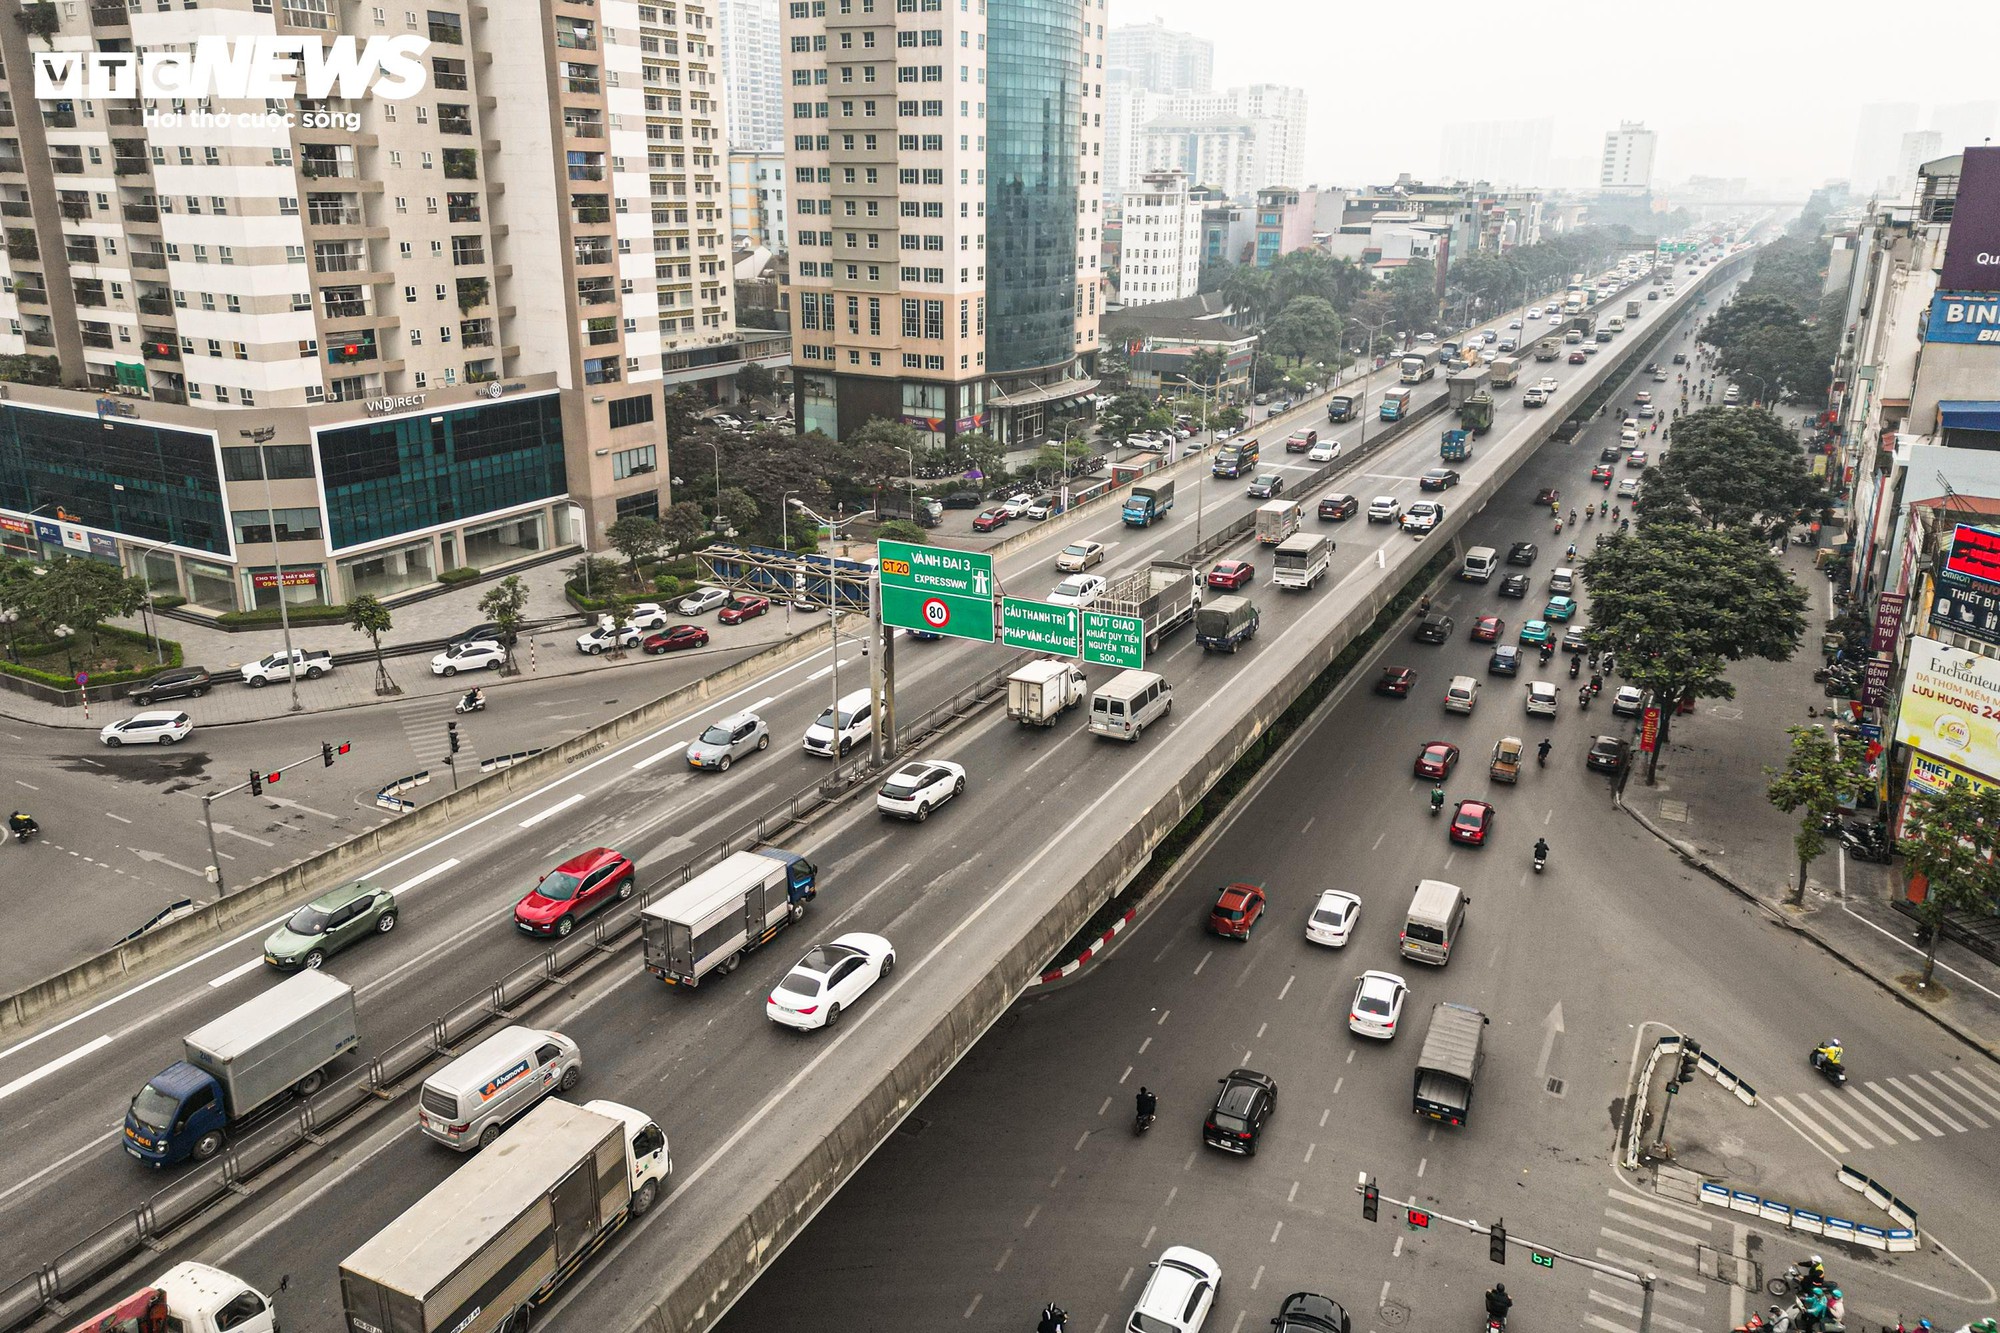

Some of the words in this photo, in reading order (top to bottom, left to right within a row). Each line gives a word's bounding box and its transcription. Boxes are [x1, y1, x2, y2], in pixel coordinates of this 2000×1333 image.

[366, 394, 426, 412] VNDIRECT
[882, 560, 909, 574] CT.20
[911, 550, 940, 567] VÀNH
[943, 556, 962, 571] ĐAI
[964, 560, 970, 571] 3
[914, 573, 967, 590] EXPRESSWAY
[1951, 588, 1982, 605] THIẾT
[1983, 597, 1995, 611] BỊ
[929, 606, 943, 620] 80
[1880, 604, 1901, 615] BỆNH
[1022, 609, 1050, 623] THANH
[1051, 613, 1066, 626] TRÌ
[1879, 615, 1897, 626] VIỆN
[1112, 619, 1135, 631] GIAO
[1004, 627, 1026, 639] PHÁP
[1086, 628, 1107, 639] KHUẤT
[1108, 632, 1122, 642] DUY
[1088, 640, 1117, 652] NGUYỄN
[1881, 640, 1887, 648] Y
[1099, 653, 1115, 662] 500
[1868, 666, 1889, 678] BỆNH
[1916, 672, 1930, 683] DA
[1933, 677, 1962, 694] THƠM
[1912, 684, 1934, 699] LƯU
[1937, 692, 1979, 715] HƯƠNG
[1916, 756, 1951, 780] THIẾT
[1972, 780, 1982, 793] Y
[496, 1063, 525, 1087] Ahamove
